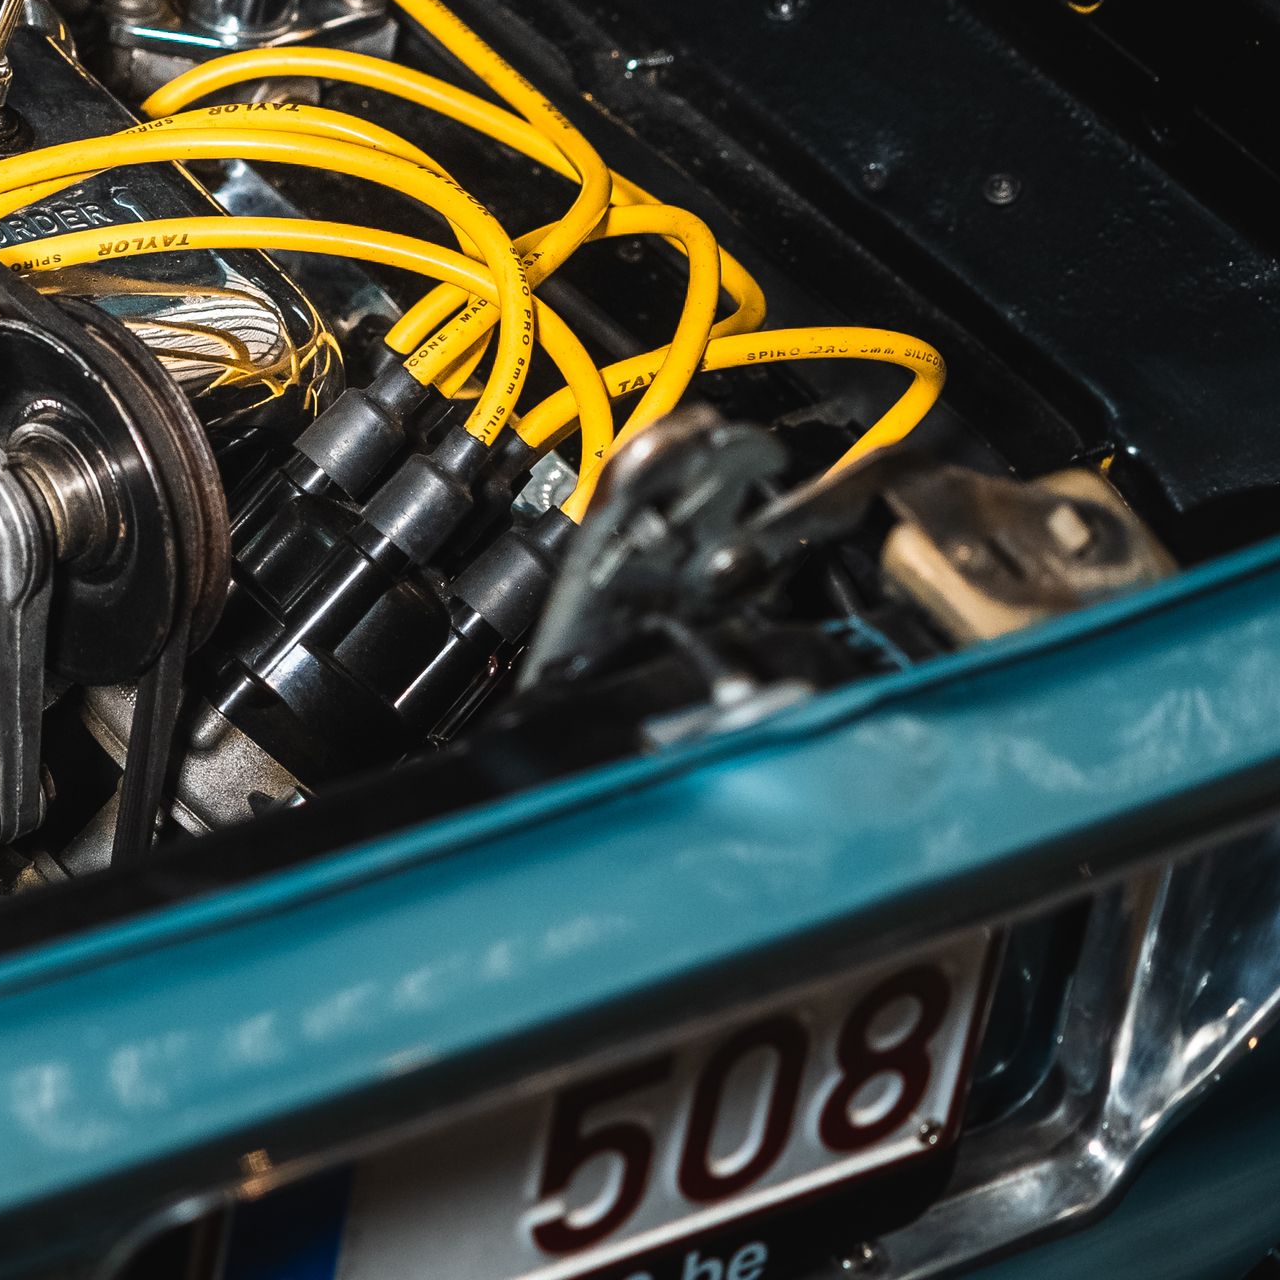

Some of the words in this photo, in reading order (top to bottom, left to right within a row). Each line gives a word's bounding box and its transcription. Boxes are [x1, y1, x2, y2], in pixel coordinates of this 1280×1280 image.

[98, 233, 190, 256] TAYLOR
[10, 254, 62, 272] SPIRO
[509, 246, 530, 296] SPIRO
[408, 333, 448, 367] CONE
[459, 298, 488, 324] MAD
[521, 309, 532, 345] PRO
[746, 347, 801, 361] SPIRO
[507, 358, 526, 395] 8mm
[532, 966, 951, 1255] 508
